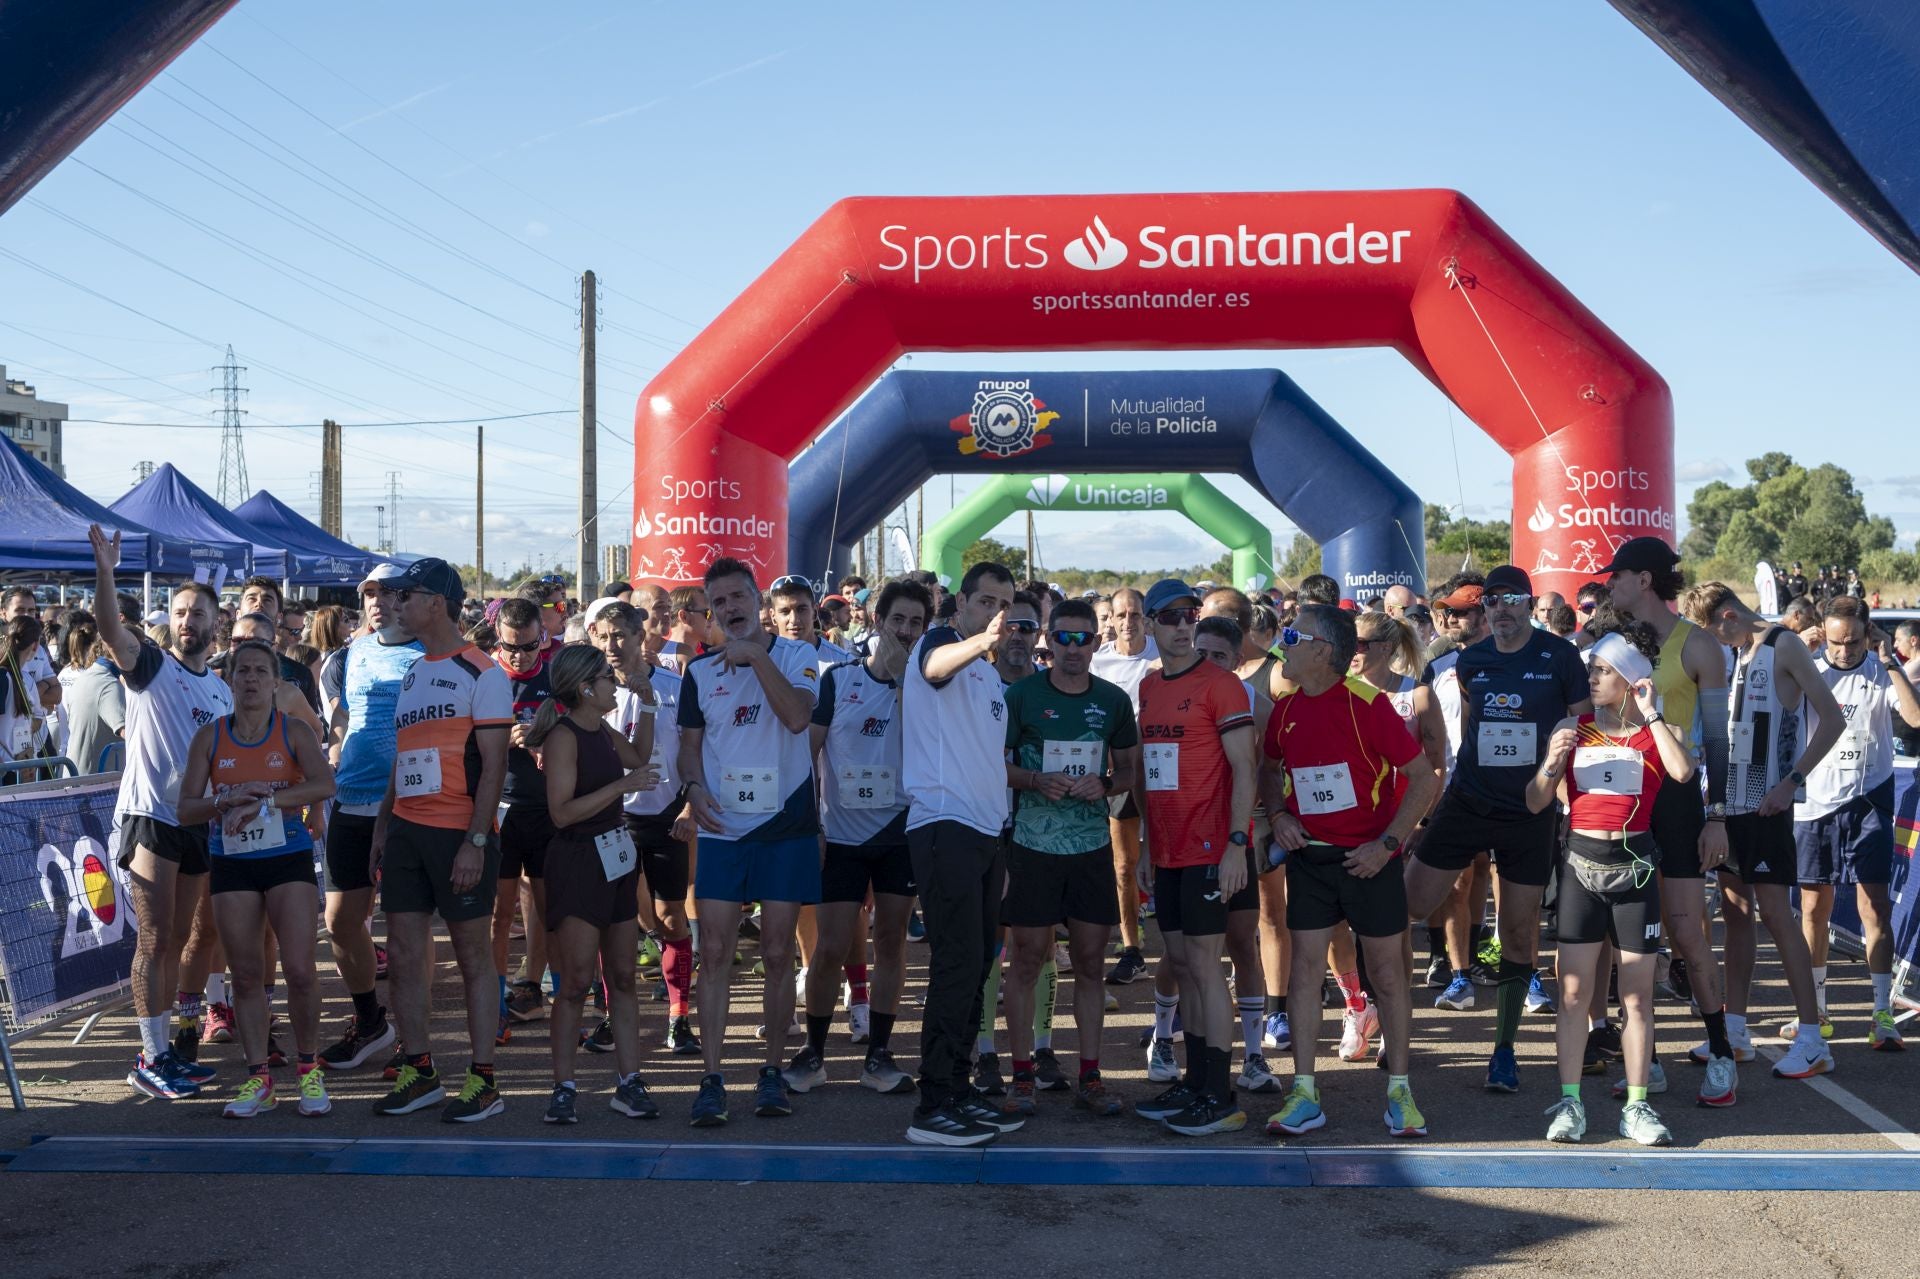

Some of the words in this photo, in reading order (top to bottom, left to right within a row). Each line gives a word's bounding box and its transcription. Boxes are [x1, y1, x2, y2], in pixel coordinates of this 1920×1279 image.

[879, 224, 1048, 283] Sports
[1138, 222, 1411, 269] Santander
[1032, 288, 1250, 314] sportssantander.es
[978, 379, 1030, 393] mupol
[1110, 396, 1205, 414] Mutualidad
[1110, 418, 1132, 435] de
[1137, 418, 1151, 435] la
[1156, 416, 1217, 434] Policía
[1565, 465, 1649, 496] Sports
[661, 475, 741, 505] Sports
[1075, 483, 1167, 508] Unicaja
[1558, 502, 1674, 531] Santander
[654, 511, 776, 539] Santander
[1344, 570, 1413, 587] fundación
[1494, 745, 1517, 756] 253
[1840, 750, 1862, 760] 297
[1062, 764, 1086, 776] 418
[1149, 767, 1159, 779] 96
[1603, 771, 1613, 783] 5
[404, 773, 423, 786] 303
[738, 791, 755, 802] 84
[858, 787, 873, 798] 85
[1312, 790, 1334, 802] 105
[240, 828, 265, 842] 317
[618, 850, 628, 863] 60
